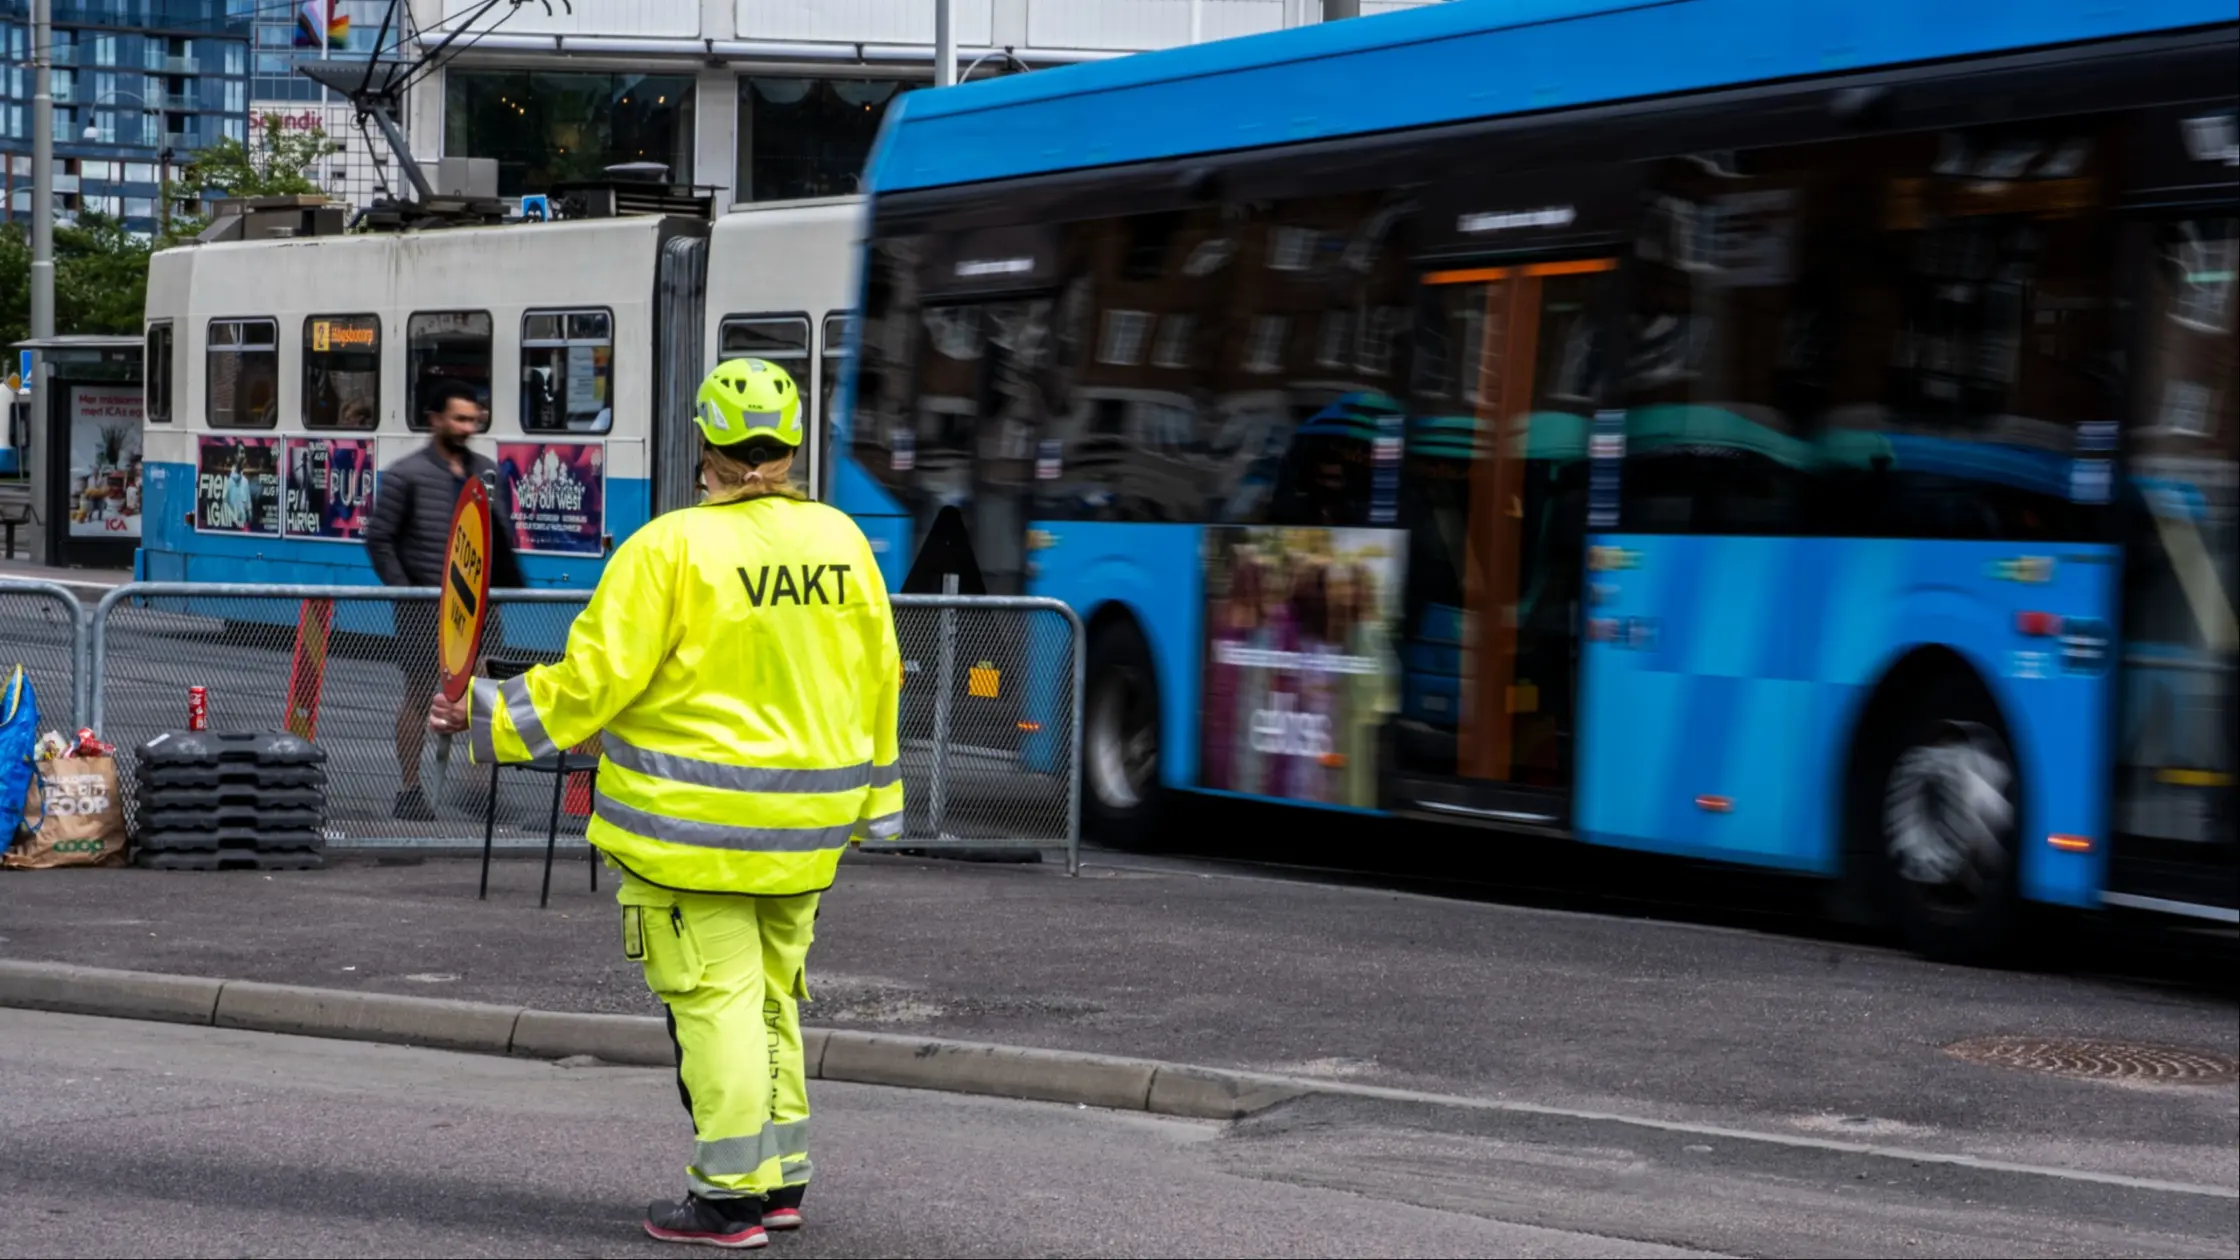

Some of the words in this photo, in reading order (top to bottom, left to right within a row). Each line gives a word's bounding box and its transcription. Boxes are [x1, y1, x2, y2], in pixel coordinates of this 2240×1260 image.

[329, 468, 372, 506] PULP
[105, 518, 127, 531] ICA
[455, 524, 482, 585] STOPP
[736, 564, 851, 608] VAKT
[451, 597, 467, 637] VAKT
[45, 796, 109, 816] COOP
